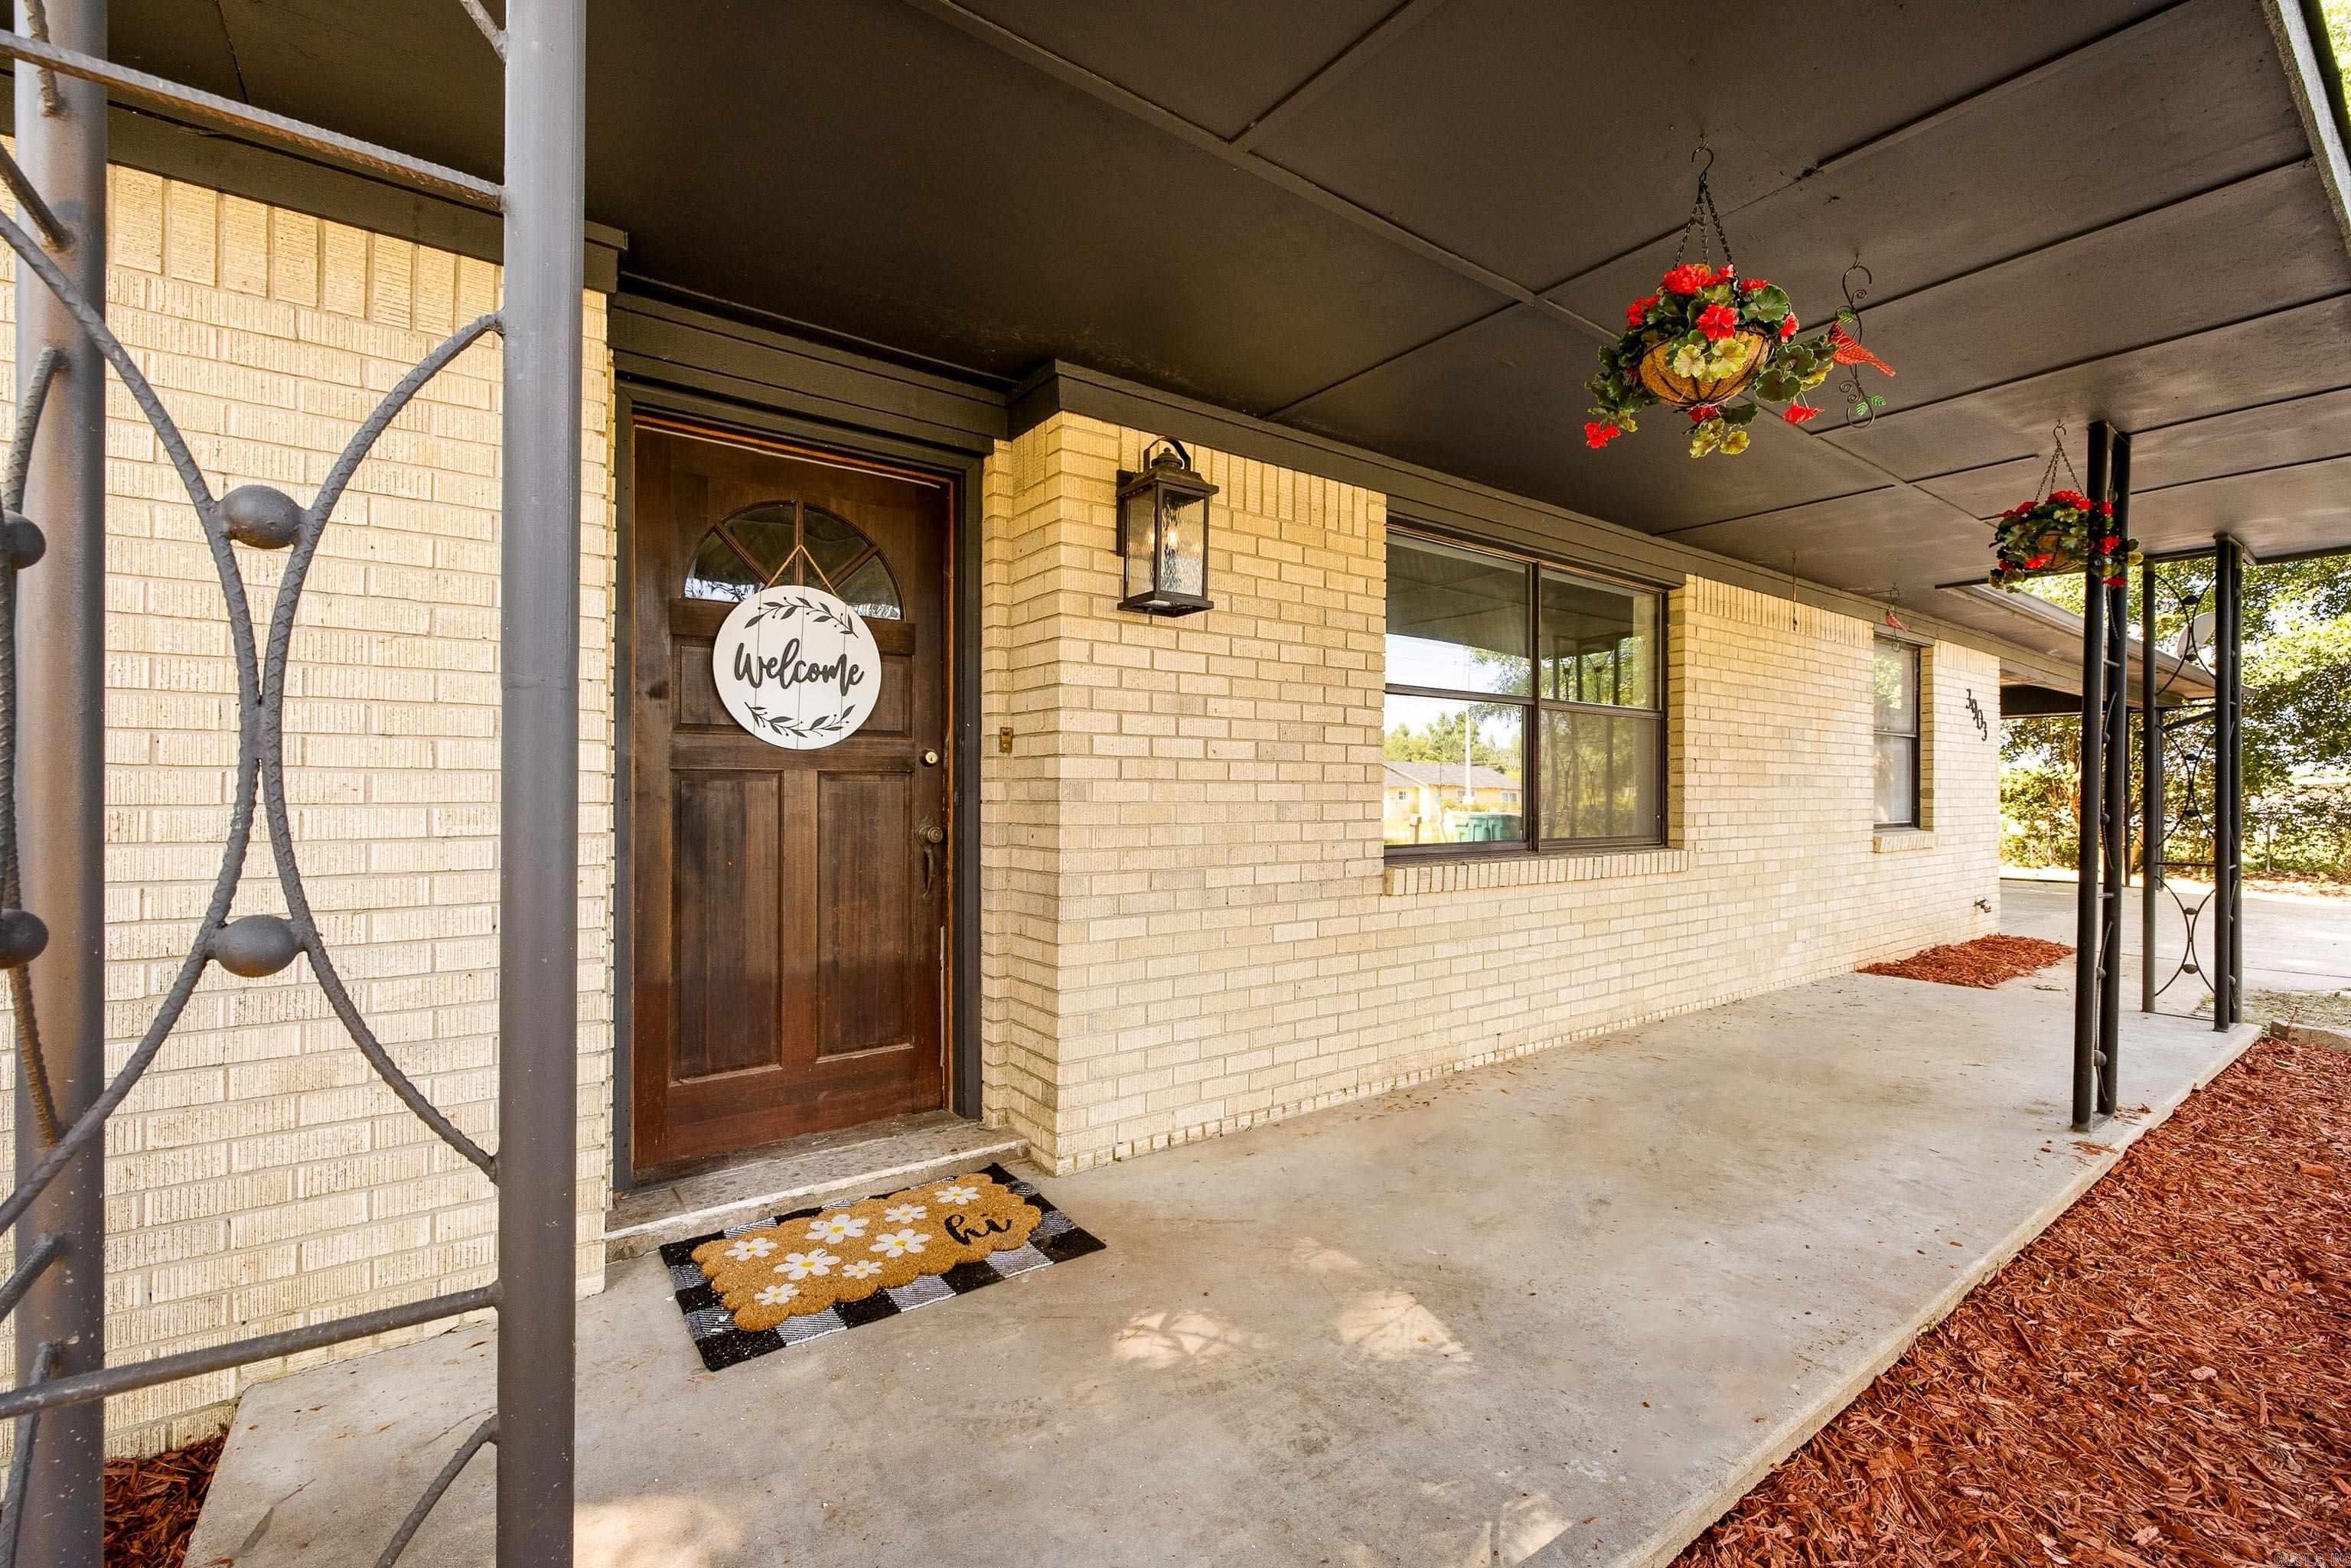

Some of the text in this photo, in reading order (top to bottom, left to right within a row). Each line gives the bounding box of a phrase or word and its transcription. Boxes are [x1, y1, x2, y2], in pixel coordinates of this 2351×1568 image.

[734, 637, 864, 696] Welcome
[1965, 689, 1987, 742] 3903
[944, 1213, 1012, 1245] hi
